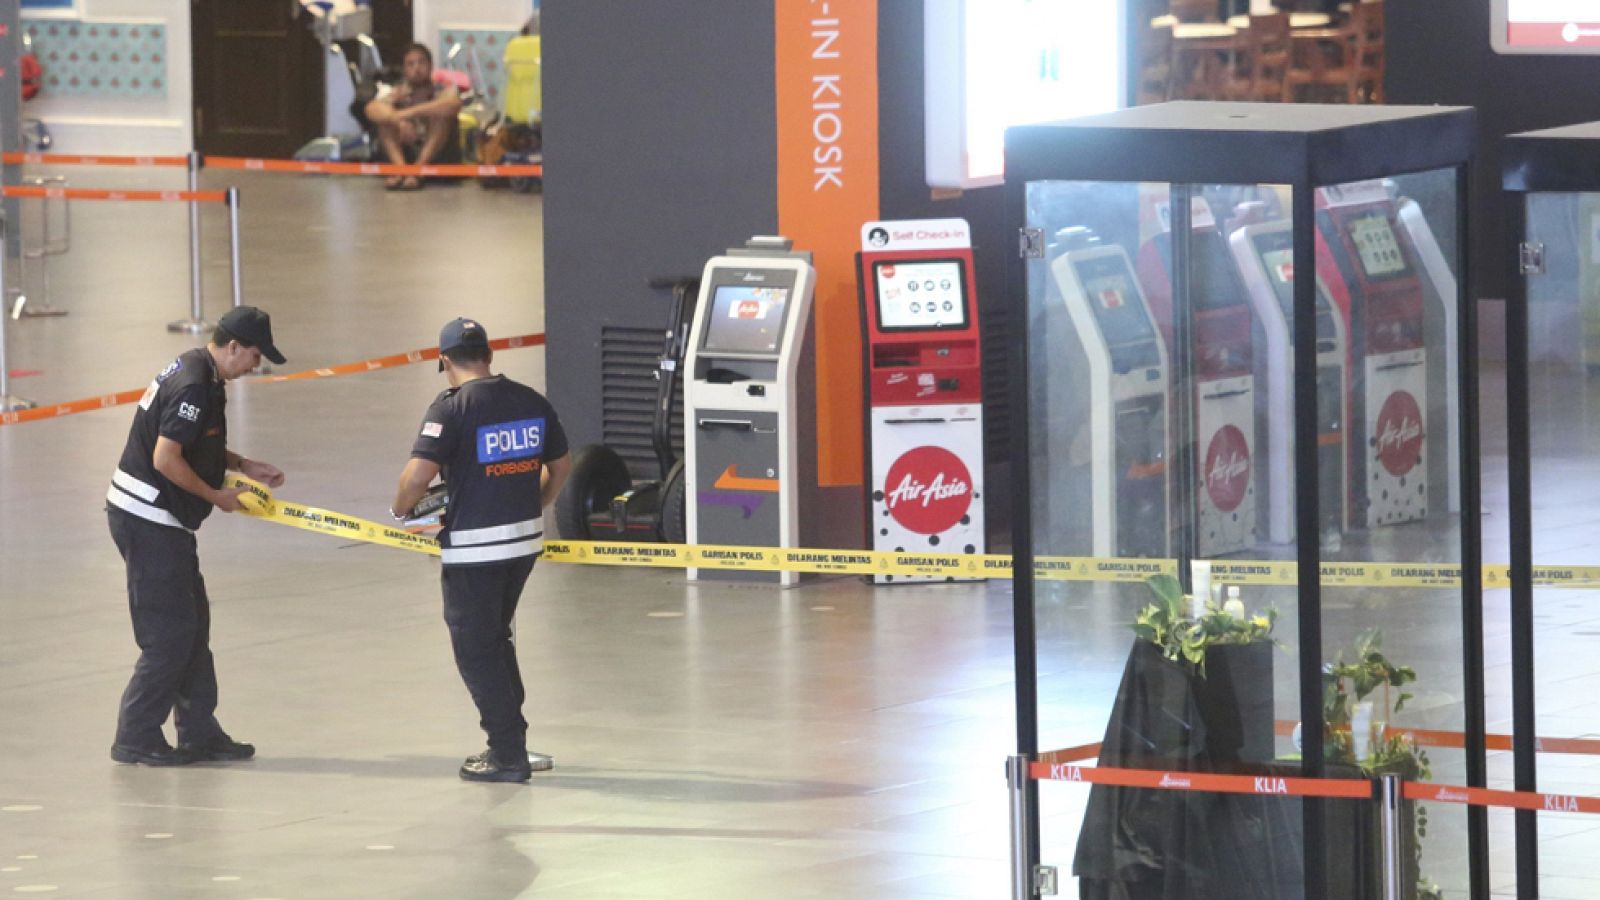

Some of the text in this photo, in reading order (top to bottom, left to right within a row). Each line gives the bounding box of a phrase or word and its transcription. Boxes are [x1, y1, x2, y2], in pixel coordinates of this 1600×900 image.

[810, 0, 843, 192] -IN KIOSK
[892, 229, 965, 241] Self Check-in
[485, 425, 540, 455] POLIS
[547, 545, 570, 553] POLIS
[594, 547, 676, 558] DILARANG MELINTAS
[702, 550, 763, 561] GARISAN POLIS
[787, 554, 872, 565] DILARANG MELINTAS
[897, 557, 960, 567] GARISAN POLIS
[1097, 563, 1161, 572] GARISAN POLIS
[1231, 566, 1272, 576] MELINTAS
[1339, 568, 1365, 576] POLIS
[1391, 568, 1436, 577] DILARANG
[1547, 570, 1573, 579] POLIS
[1051, 764, 1082, 782] KLIA
[1254, 776, 1288, 793] KLIA
[1543, 794, 1579, 812] KLIA
